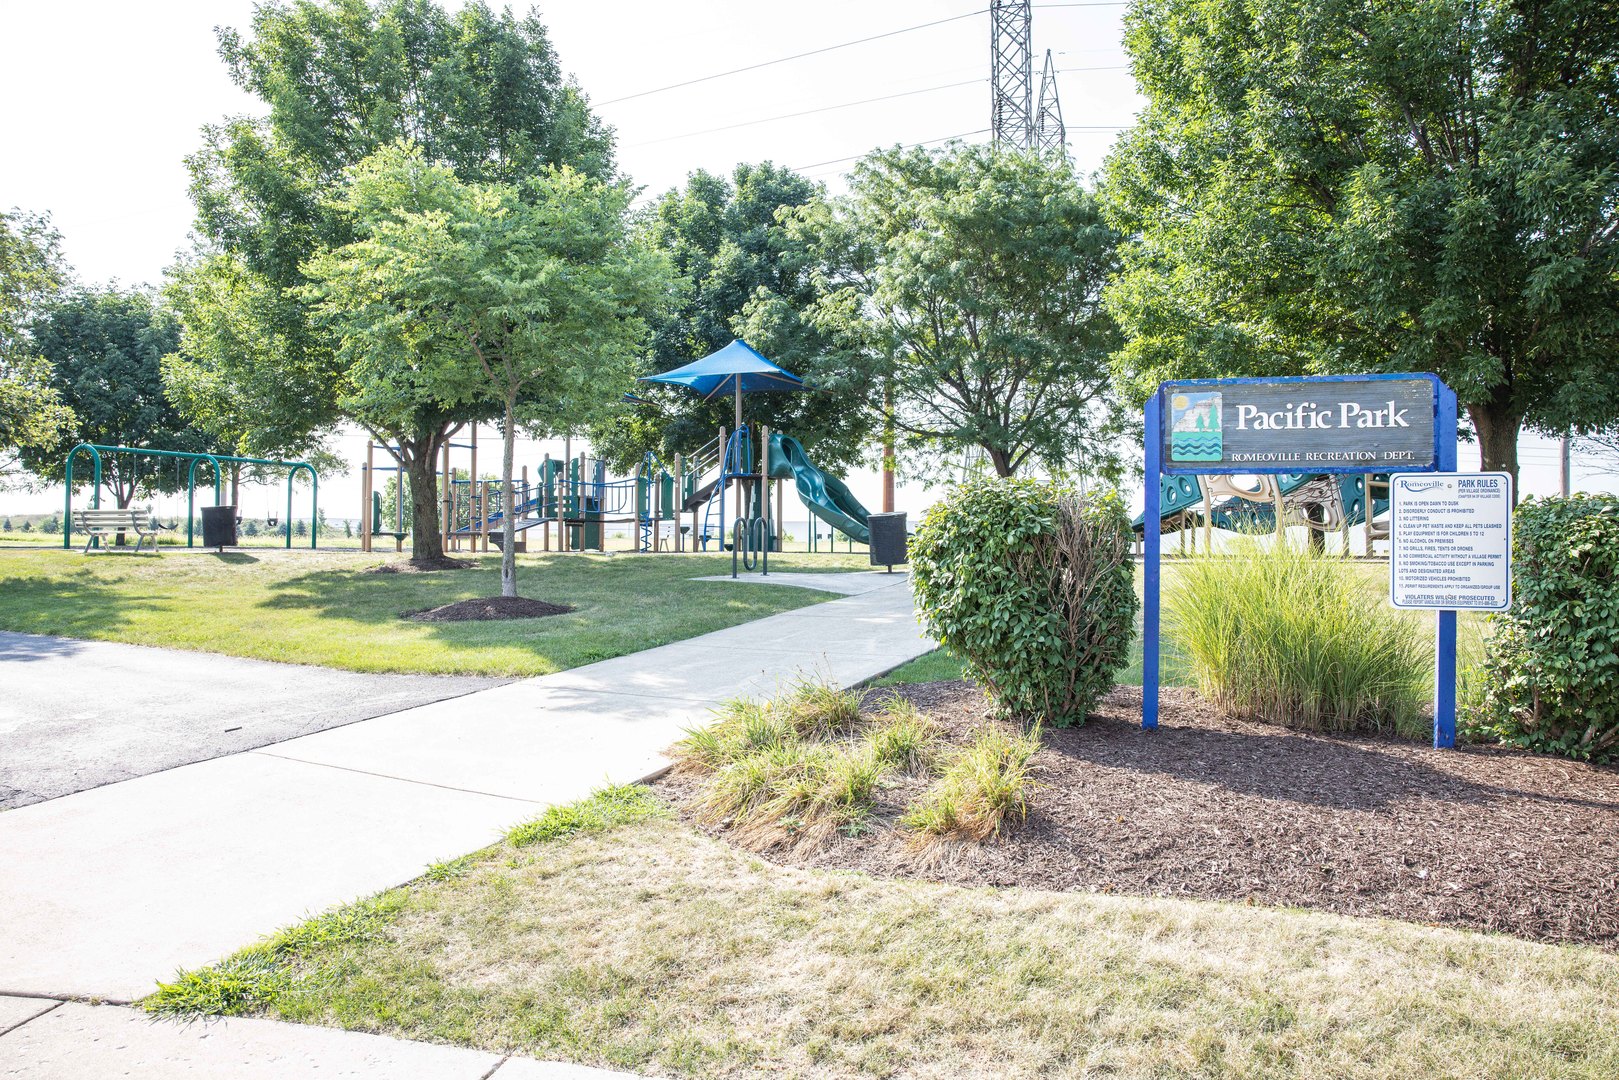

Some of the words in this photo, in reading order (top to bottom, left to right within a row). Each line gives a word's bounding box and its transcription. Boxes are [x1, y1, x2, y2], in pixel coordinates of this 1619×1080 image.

[1235, 403, 1334, 430] Pacific
[1338, 401, 1409, 428] Park
[1232, 453, 1300, 462] ROMEOVILLE
[1306, 452, 1376, 461] RECREATION
[1384, 451, 1415, 460] DEPT.
[1401, 480, 1443, 492] Romeoville
